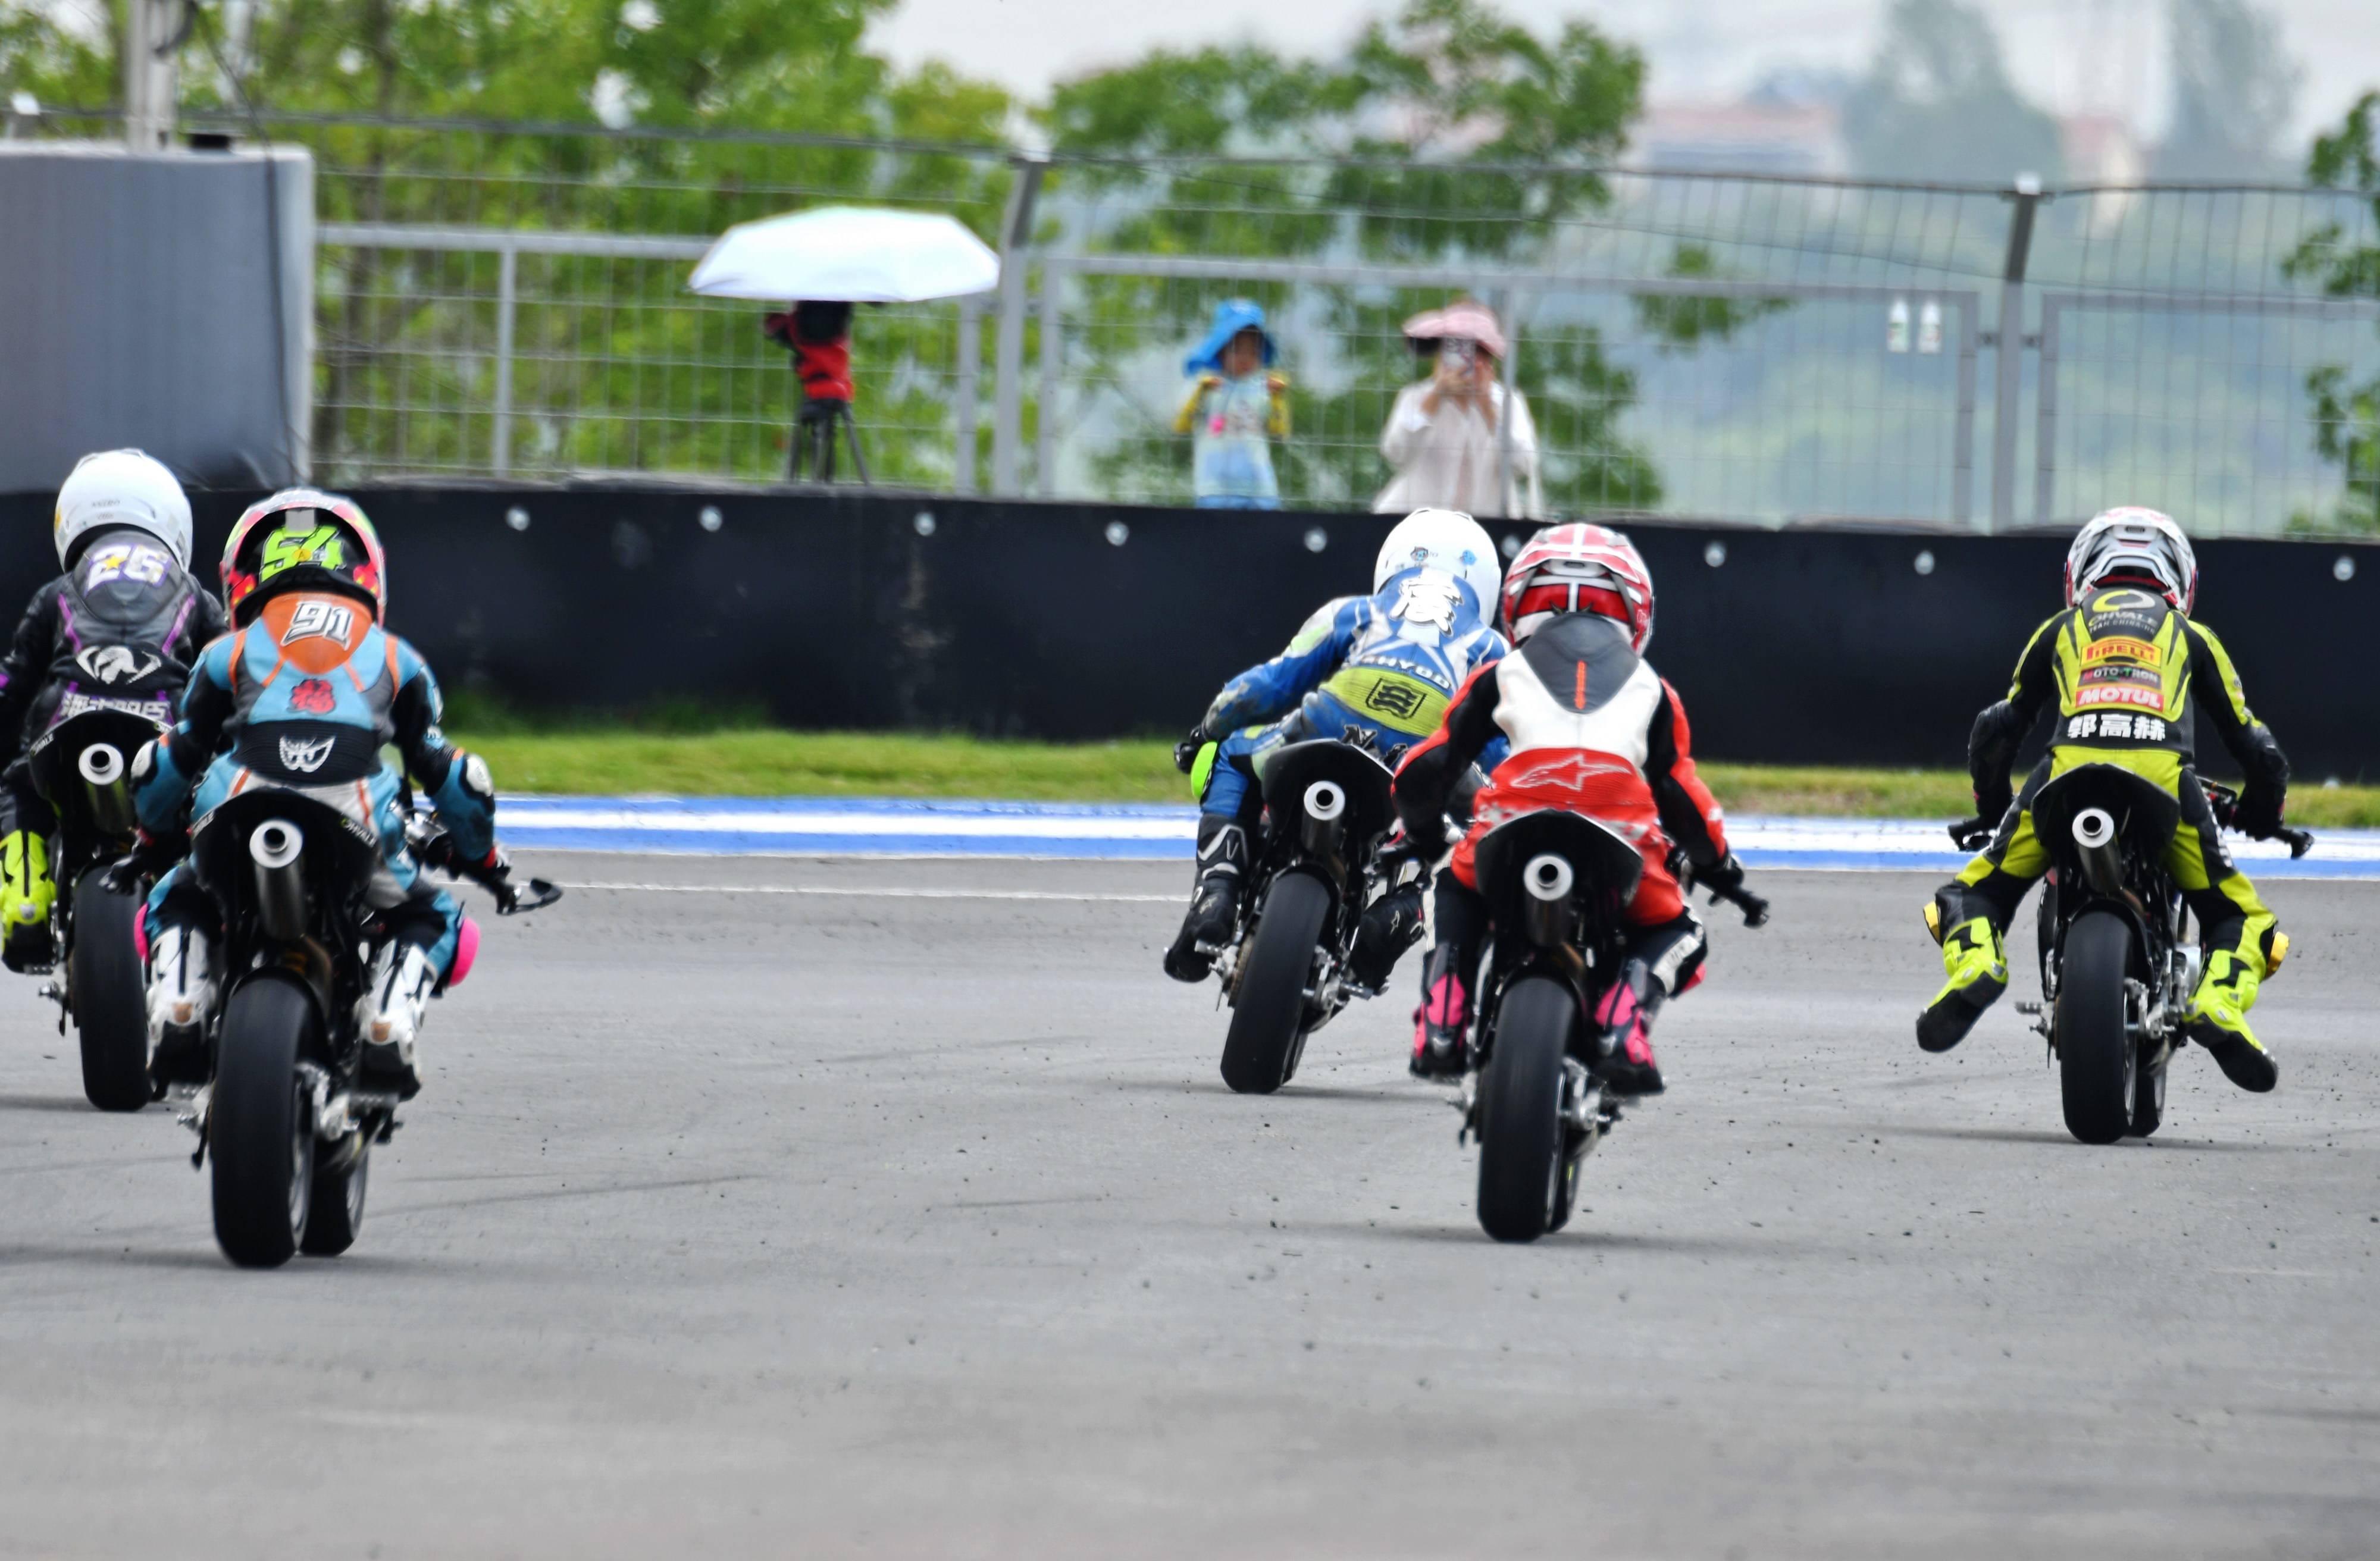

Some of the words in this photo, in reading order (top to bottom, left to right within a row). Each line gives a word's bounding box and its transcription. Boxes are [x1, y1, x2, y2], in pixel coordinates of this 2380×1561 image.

[280, 600, 353, 651] 91
[2087, 638, 2155, 660] PIRELLI
[2079, 687, 2161, 709] MOTUL
